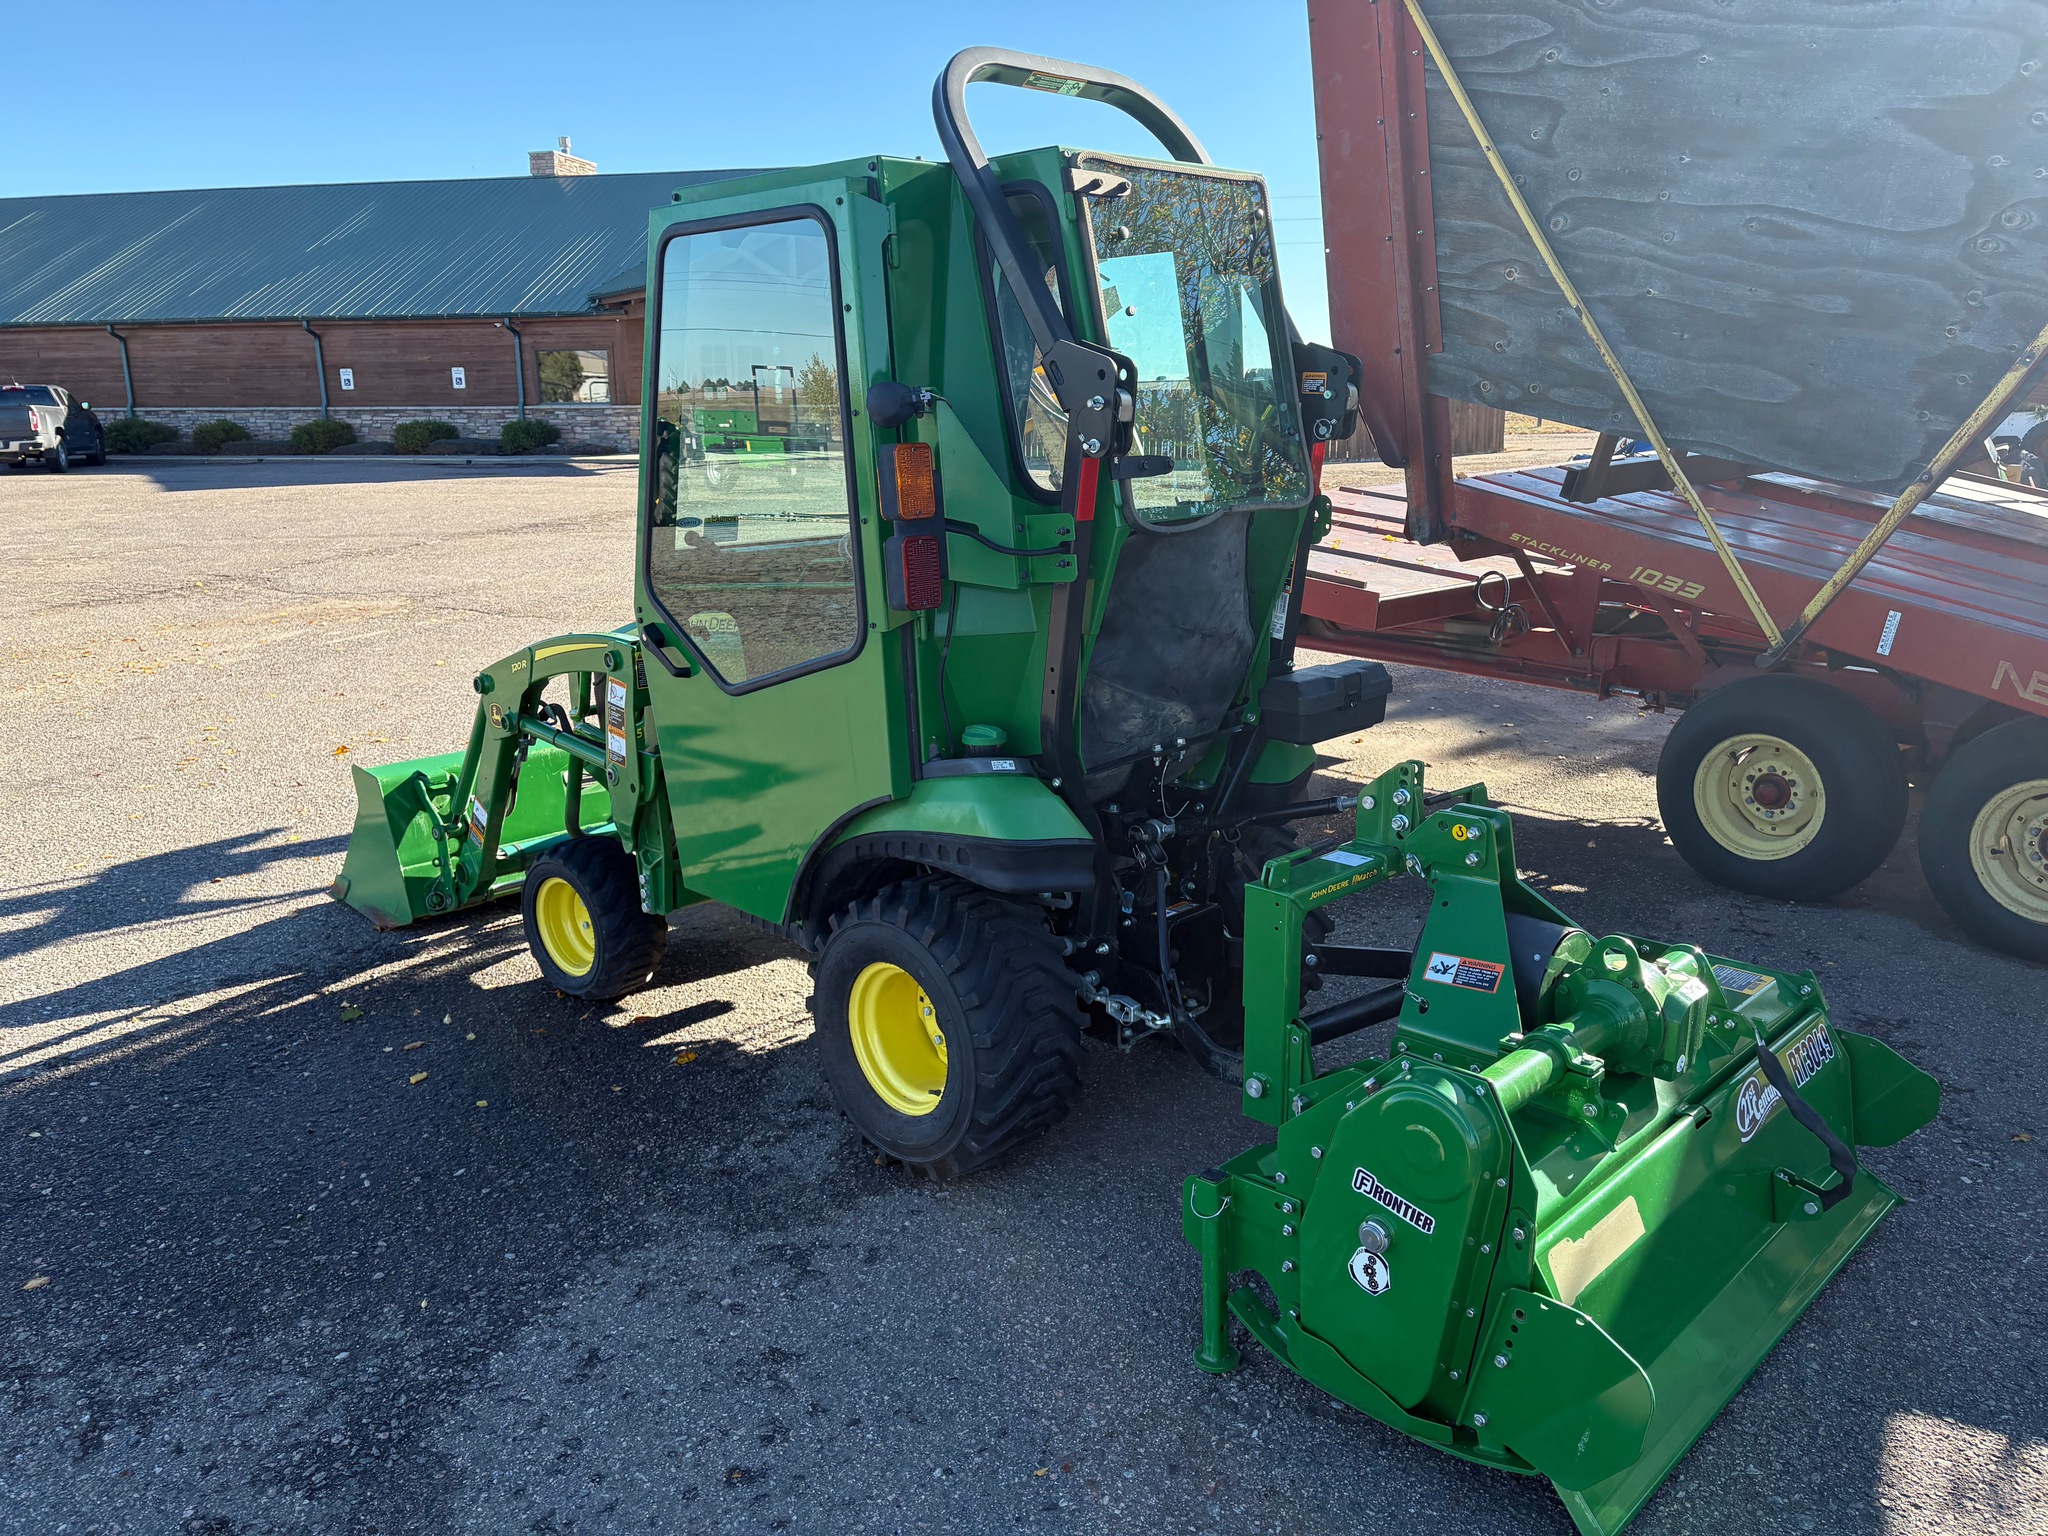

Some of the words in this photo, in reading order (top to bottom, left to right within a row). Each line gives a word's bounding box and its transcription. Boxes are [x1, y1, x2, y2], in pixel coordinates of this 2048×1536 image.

[1509, 532, 1613, 572] STACKLINER
[1628, 566, 1706, 599] 1033
[1309, 887, 1328, 900] JOHN
[1328, 879, 1350, 893] DEERE
[1467, 959, 1497, 970] WARNING
[1786, 1023, 1835, 1089] RT3049
[1353, 1168, 1435, 1233] FRONTIER
